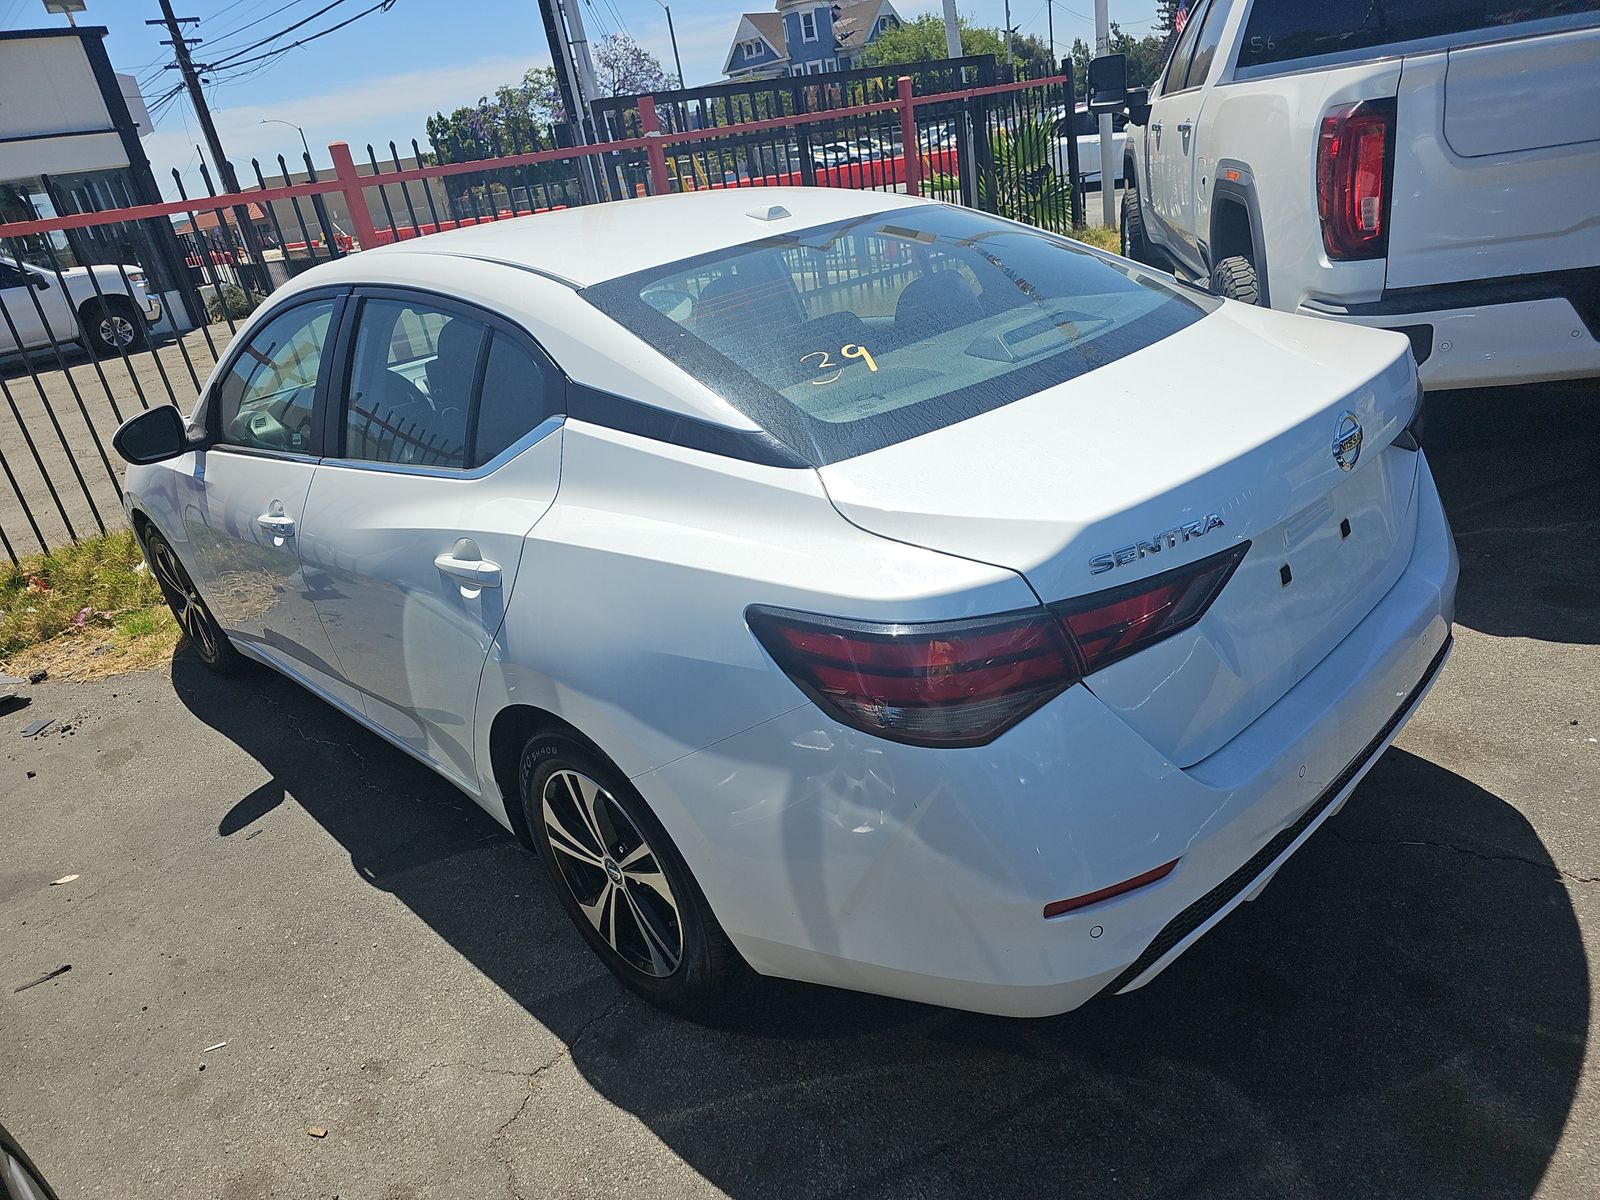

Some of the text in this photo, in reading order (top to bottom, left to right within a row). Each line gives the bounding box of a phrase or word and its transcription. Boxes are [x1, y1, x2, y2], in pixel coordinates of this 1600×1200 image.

[1250, 35, 1276, 54] 56
[799, 343, 878, 385] 39
[1088, 512, 1225, 576] SENTRA
